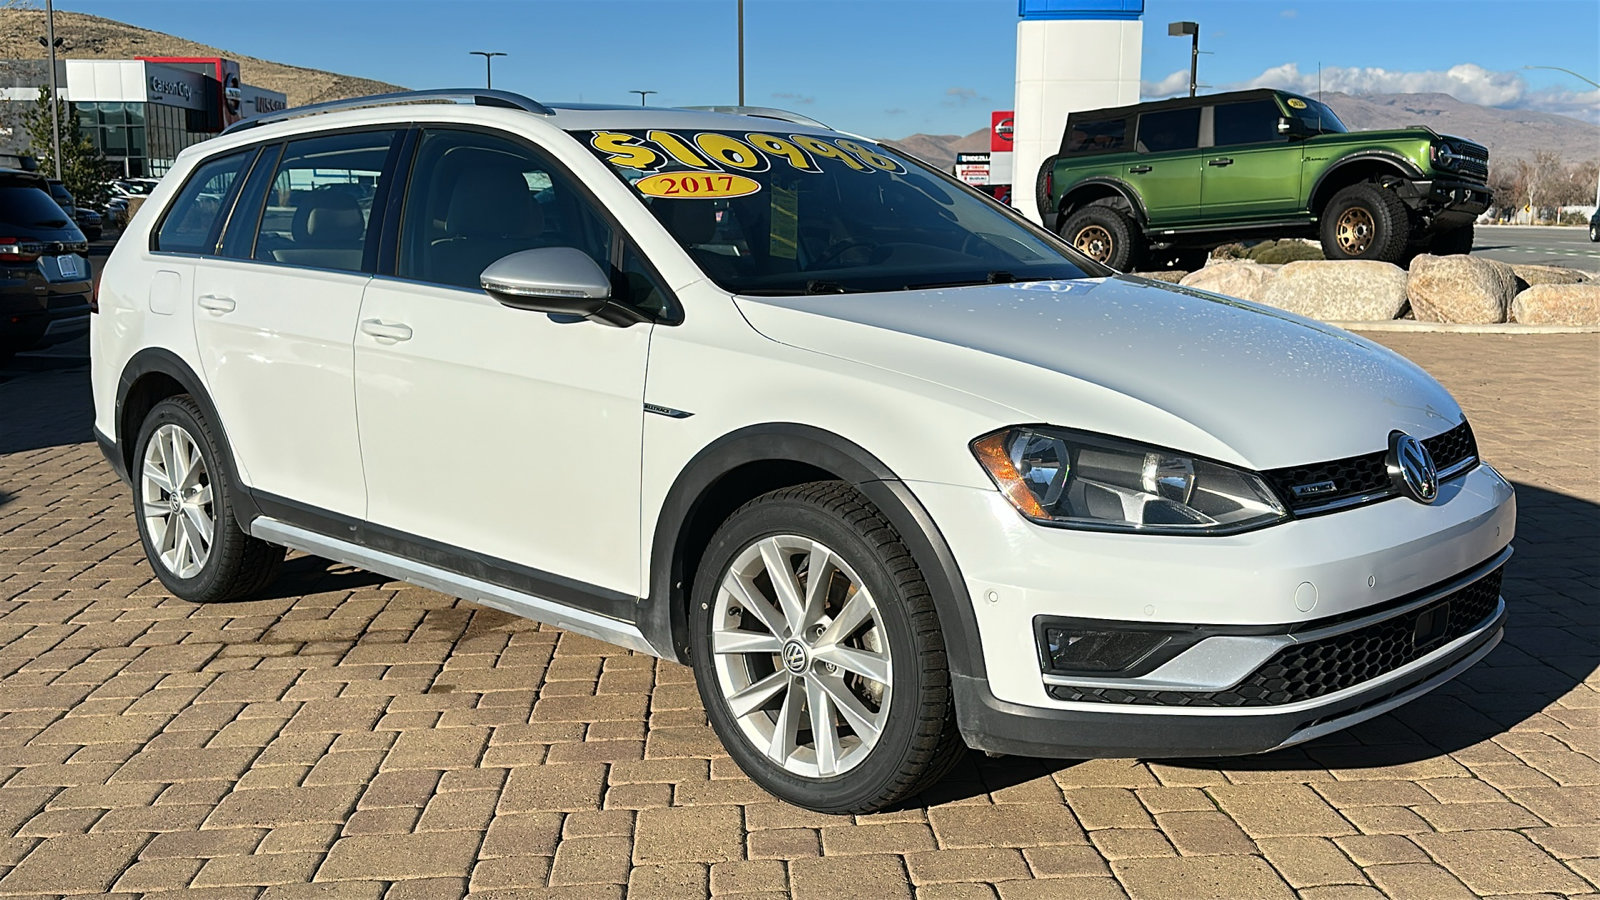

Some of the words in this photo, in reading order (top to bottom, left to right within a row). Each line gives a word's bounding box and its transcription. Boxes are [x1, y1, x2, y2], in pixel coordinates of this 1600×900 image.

[152, 76, 178, 95] Carson
[178, 82, 192, 100] City
[590, 130, 906, 174] $10998
[660, 176, 733, 195] 2017
